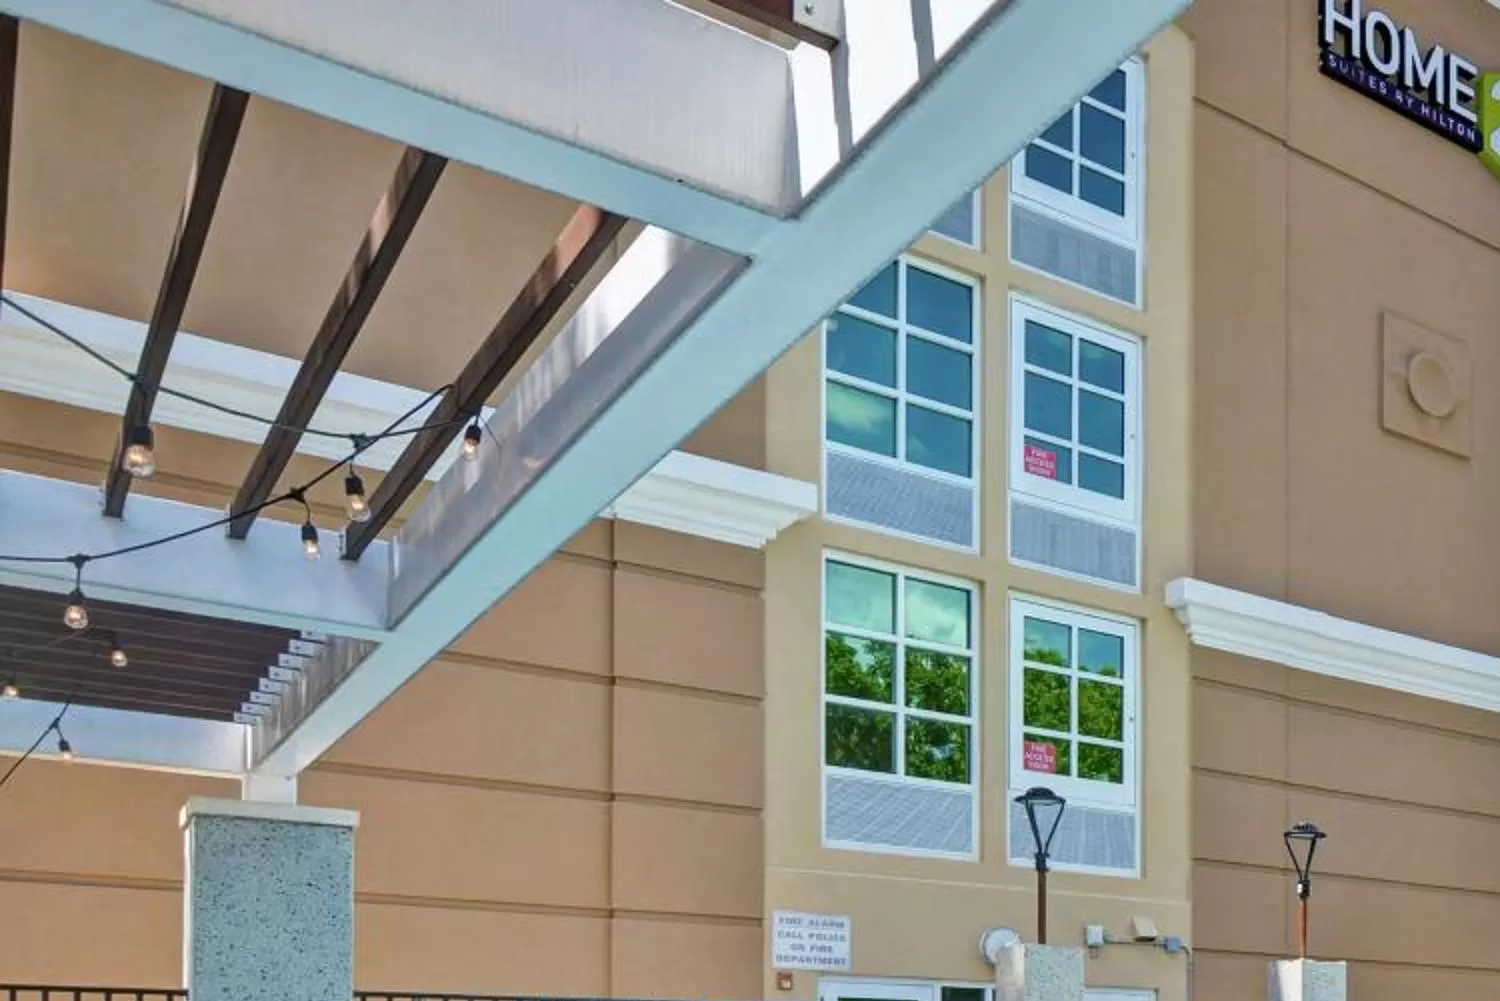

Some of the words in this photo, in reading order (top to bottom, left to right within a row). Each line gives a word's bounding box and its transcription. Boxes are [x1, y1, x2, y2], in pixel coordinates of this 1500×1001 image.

[1325, 0, 1477, 123] HOME
[1328, 53, 1388, 98] SUITES
[1421, 104, 1475, 142] HILTON
[775, 955, 847, 966] DEPARTMENT
